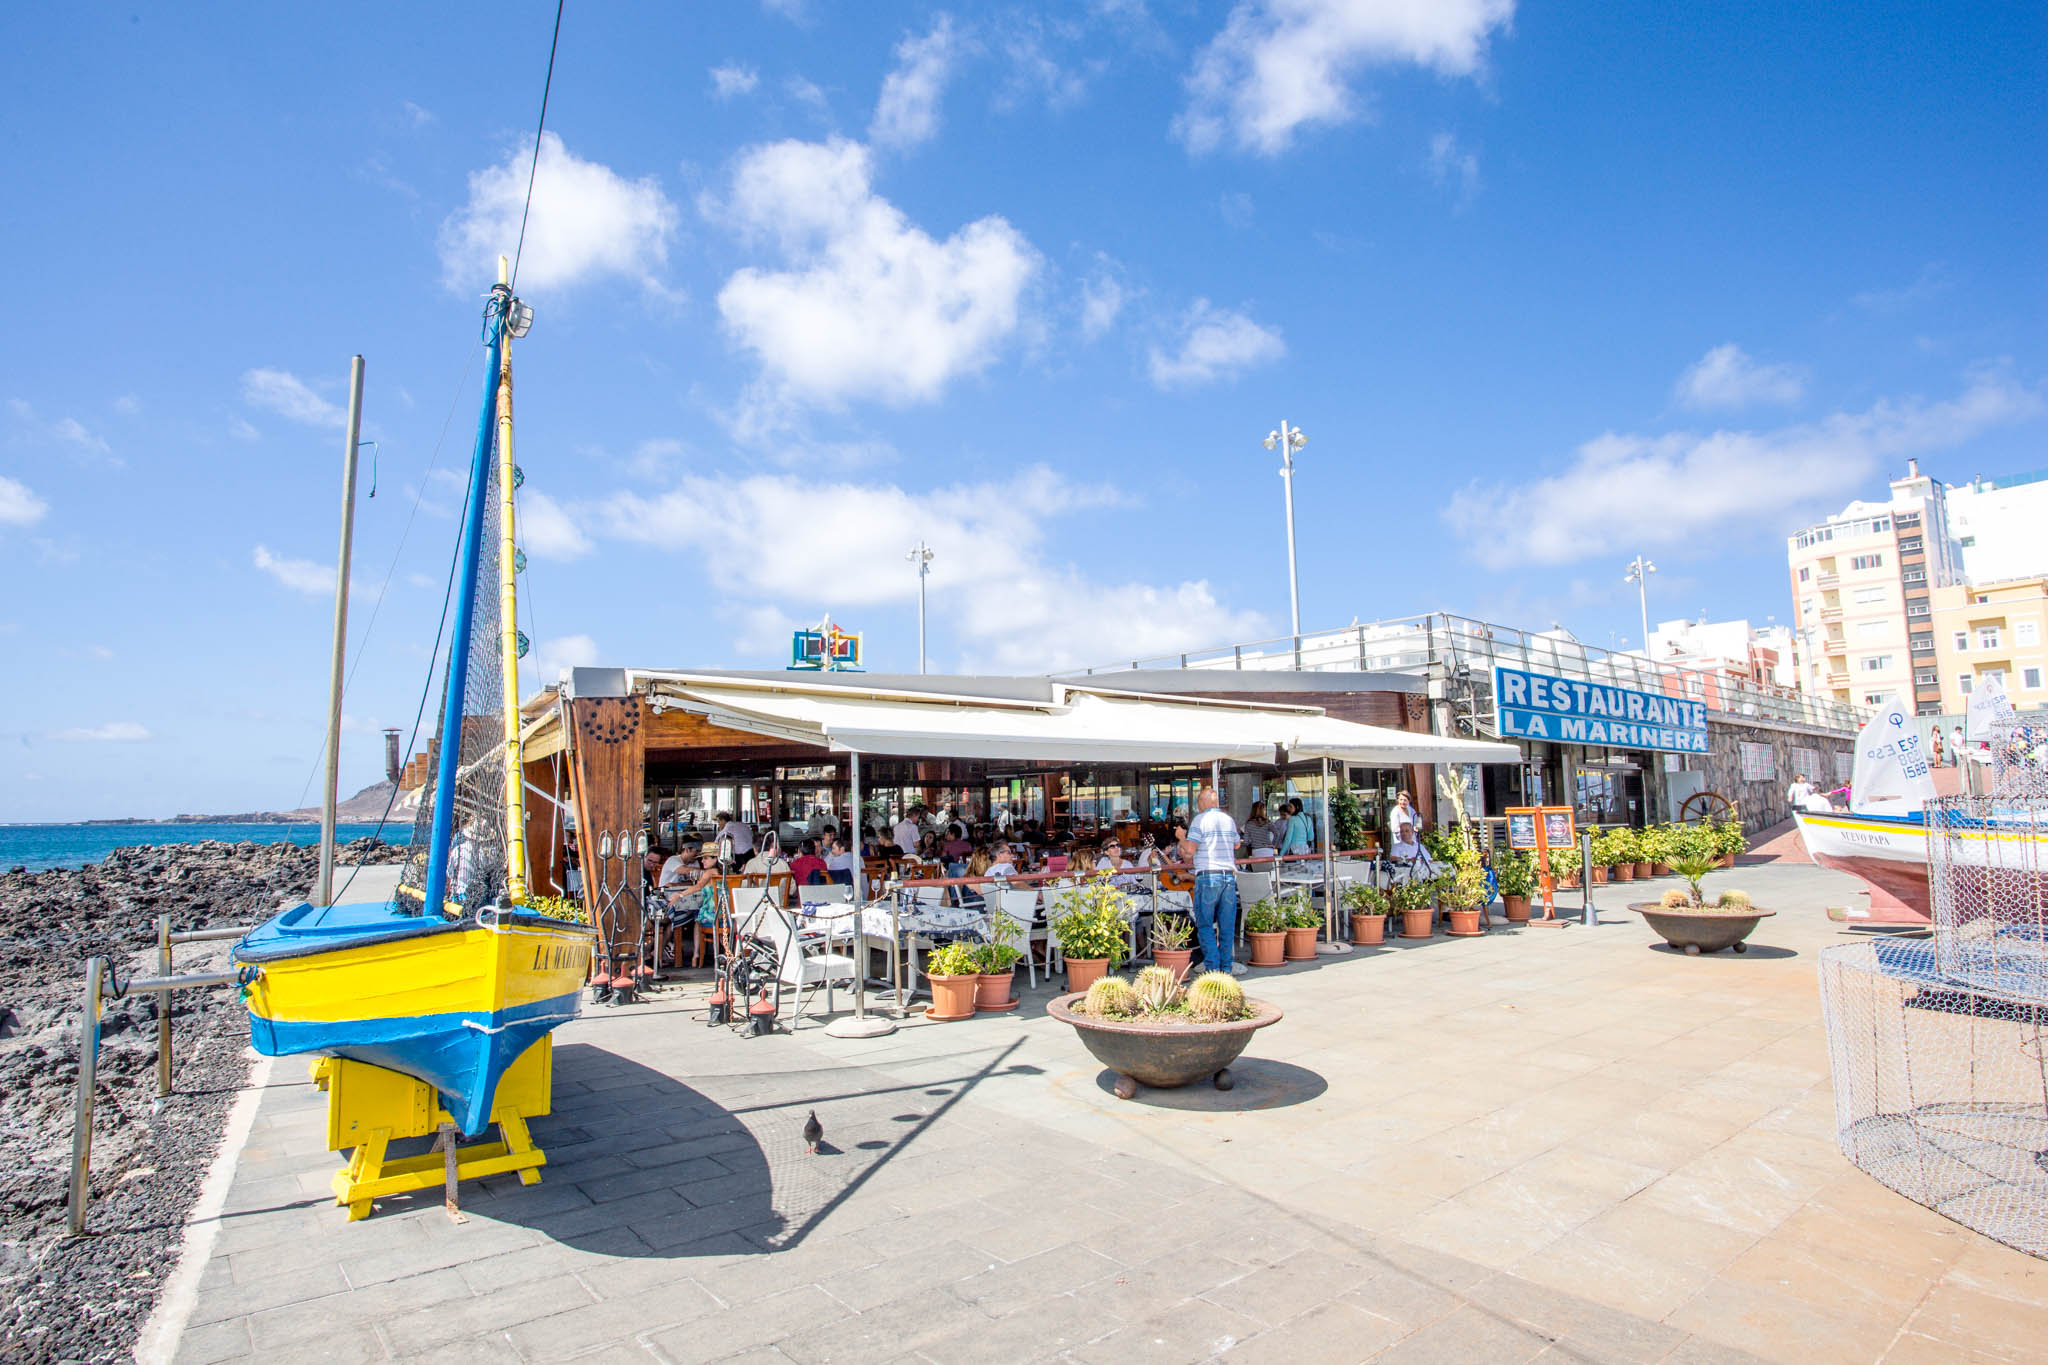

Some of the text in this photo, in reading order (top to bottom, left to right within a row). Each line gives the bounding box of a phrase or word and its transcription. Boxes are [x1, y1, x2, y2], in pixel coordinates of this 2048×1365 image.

[1502, 671, 1707, 730] RESTAURANTE
[1504, 711, 1707, 752] LA MARINERA
[1897, 735, 1919, 752] ESP
